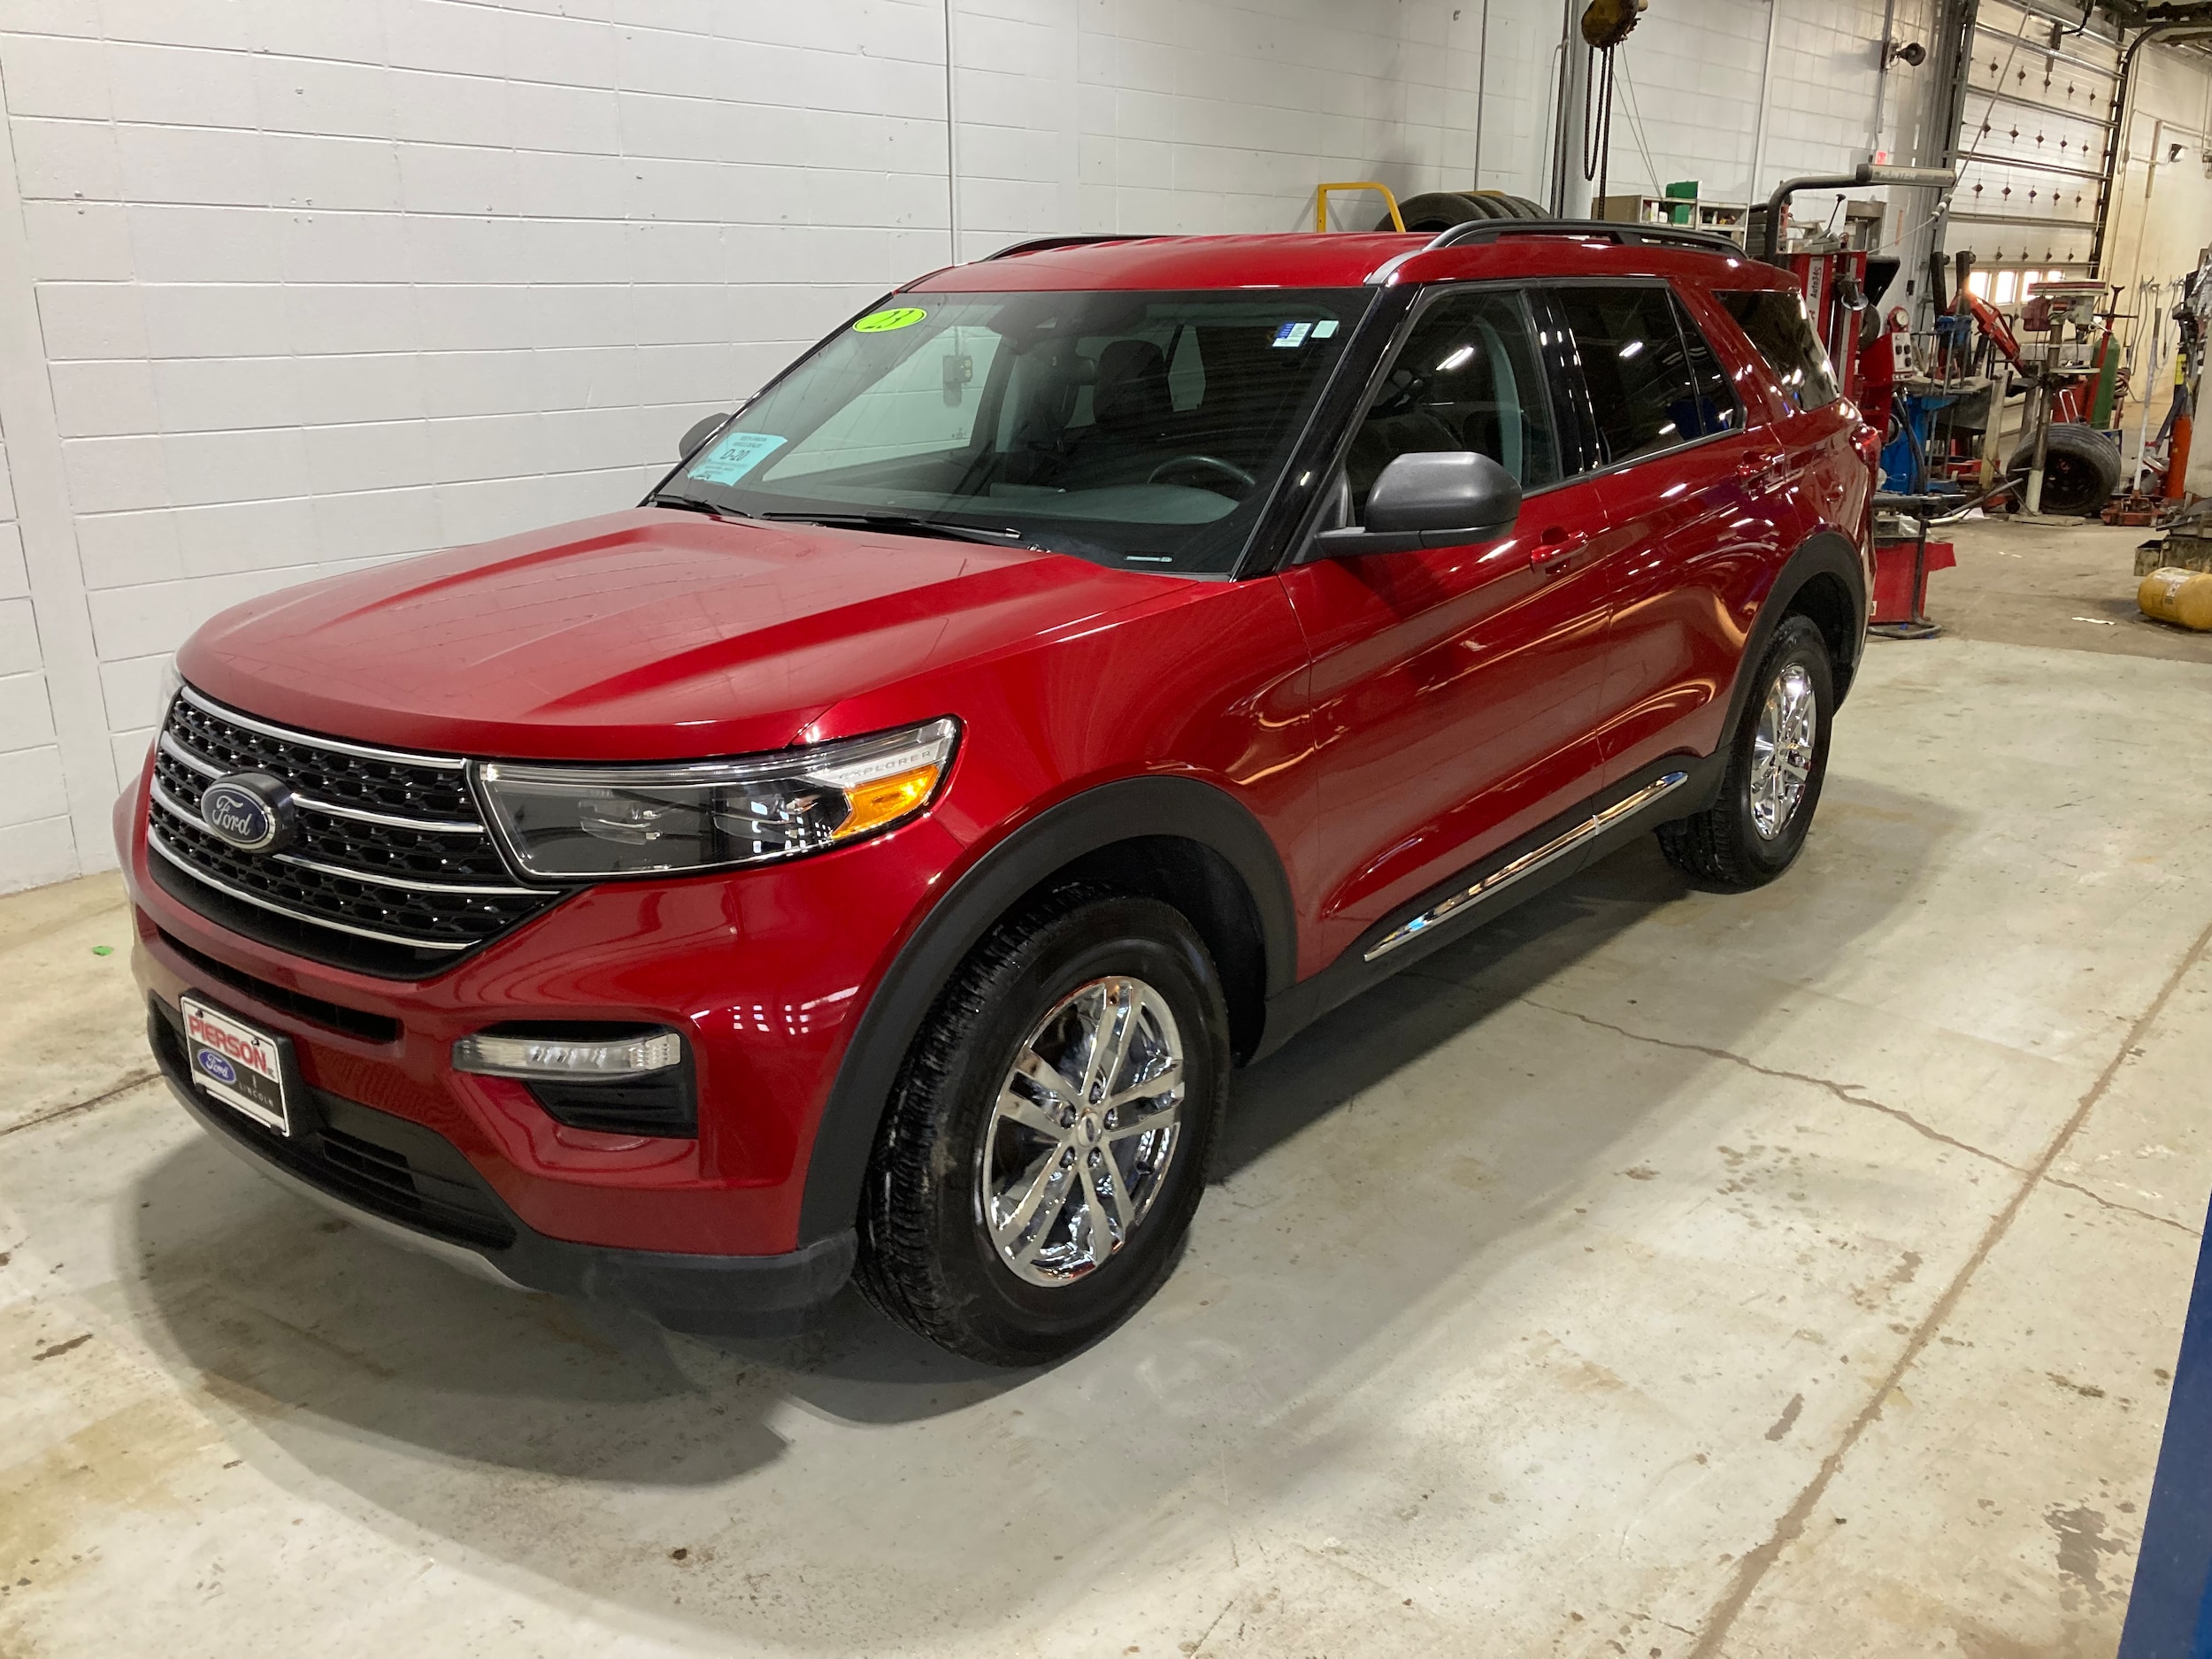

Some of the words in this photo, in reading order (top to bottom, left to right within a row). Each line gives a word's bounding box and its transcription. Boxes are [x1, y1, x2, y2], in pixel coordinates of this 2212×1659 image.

[840, 750, 931, 779] EXPLORER
[213, 795, 252, 835] Ford
[188, 1017, 267, 1073] PIERSON
[207, 1054, 229, 1079] Ford
